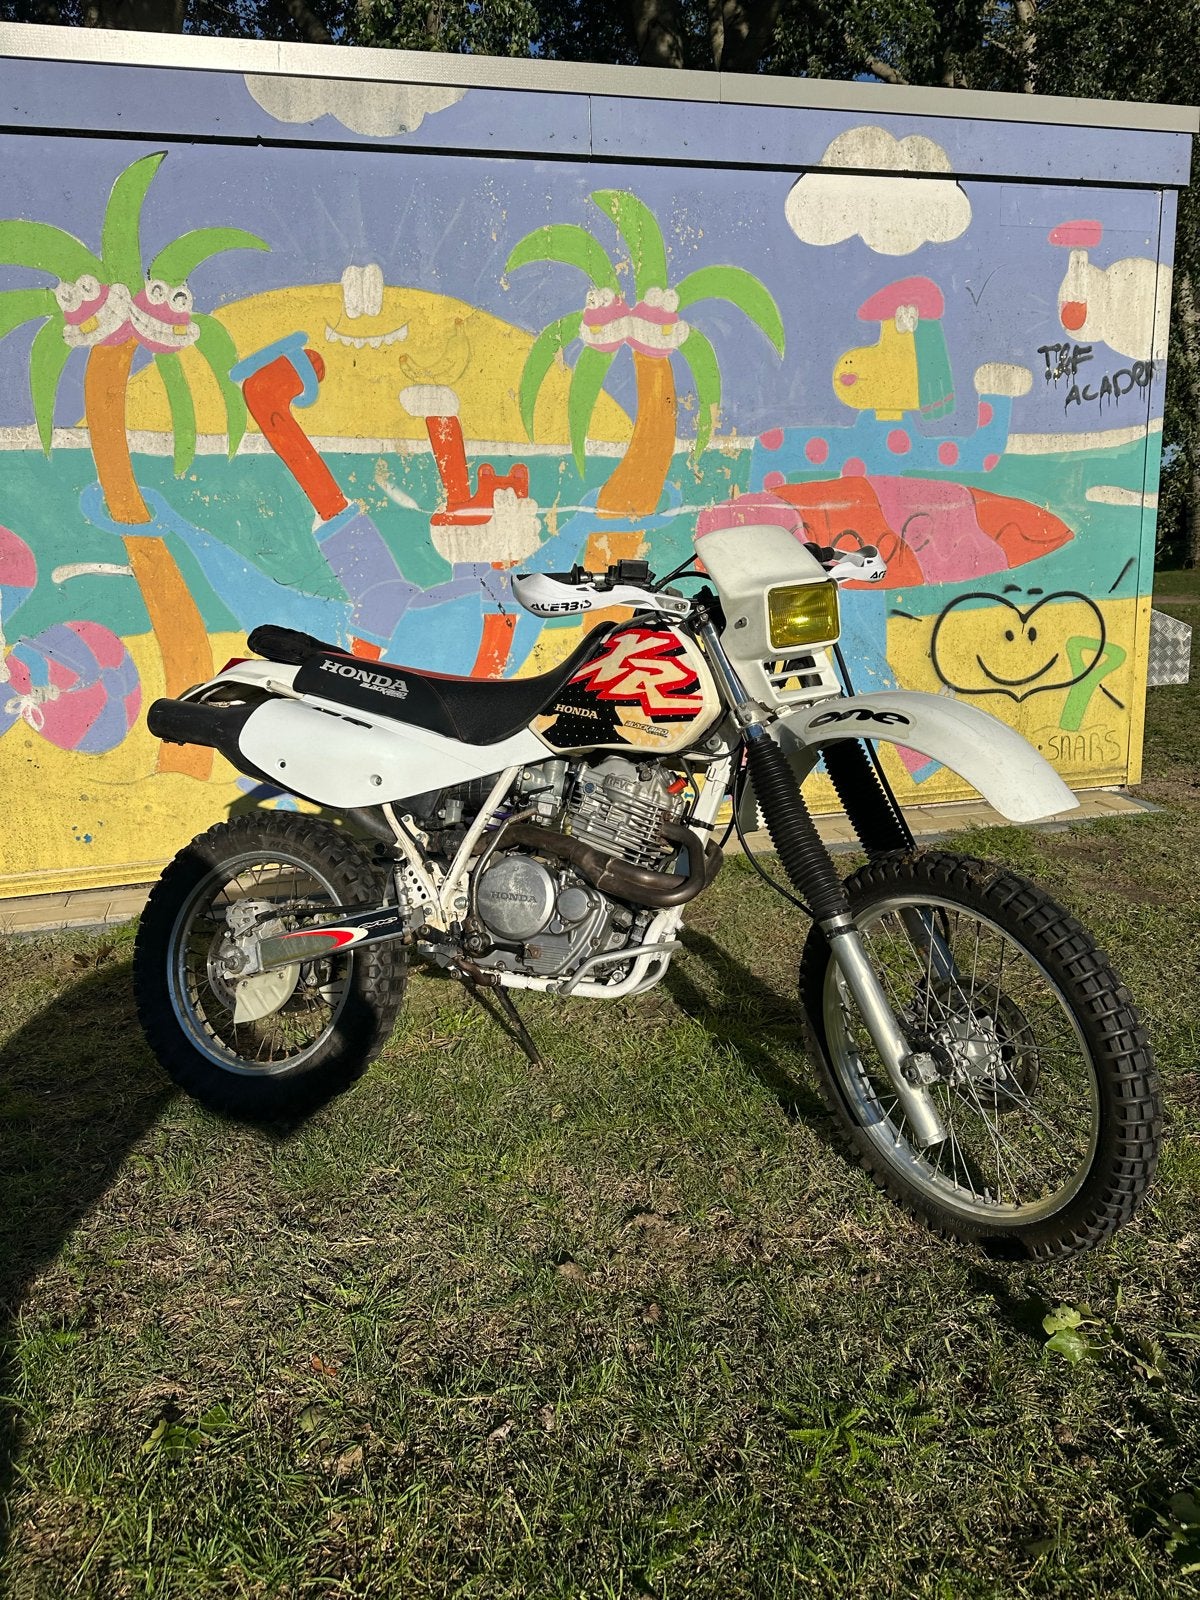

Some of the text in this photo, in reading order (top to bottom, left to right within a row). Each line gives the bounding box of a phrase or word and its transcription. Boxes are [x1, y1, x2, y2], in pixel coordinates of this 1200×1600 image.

[319, 659, 410, 693] HONDA
[554, 703, 599, 720] HONDA
[490, 891, 537, 903] HONDA
